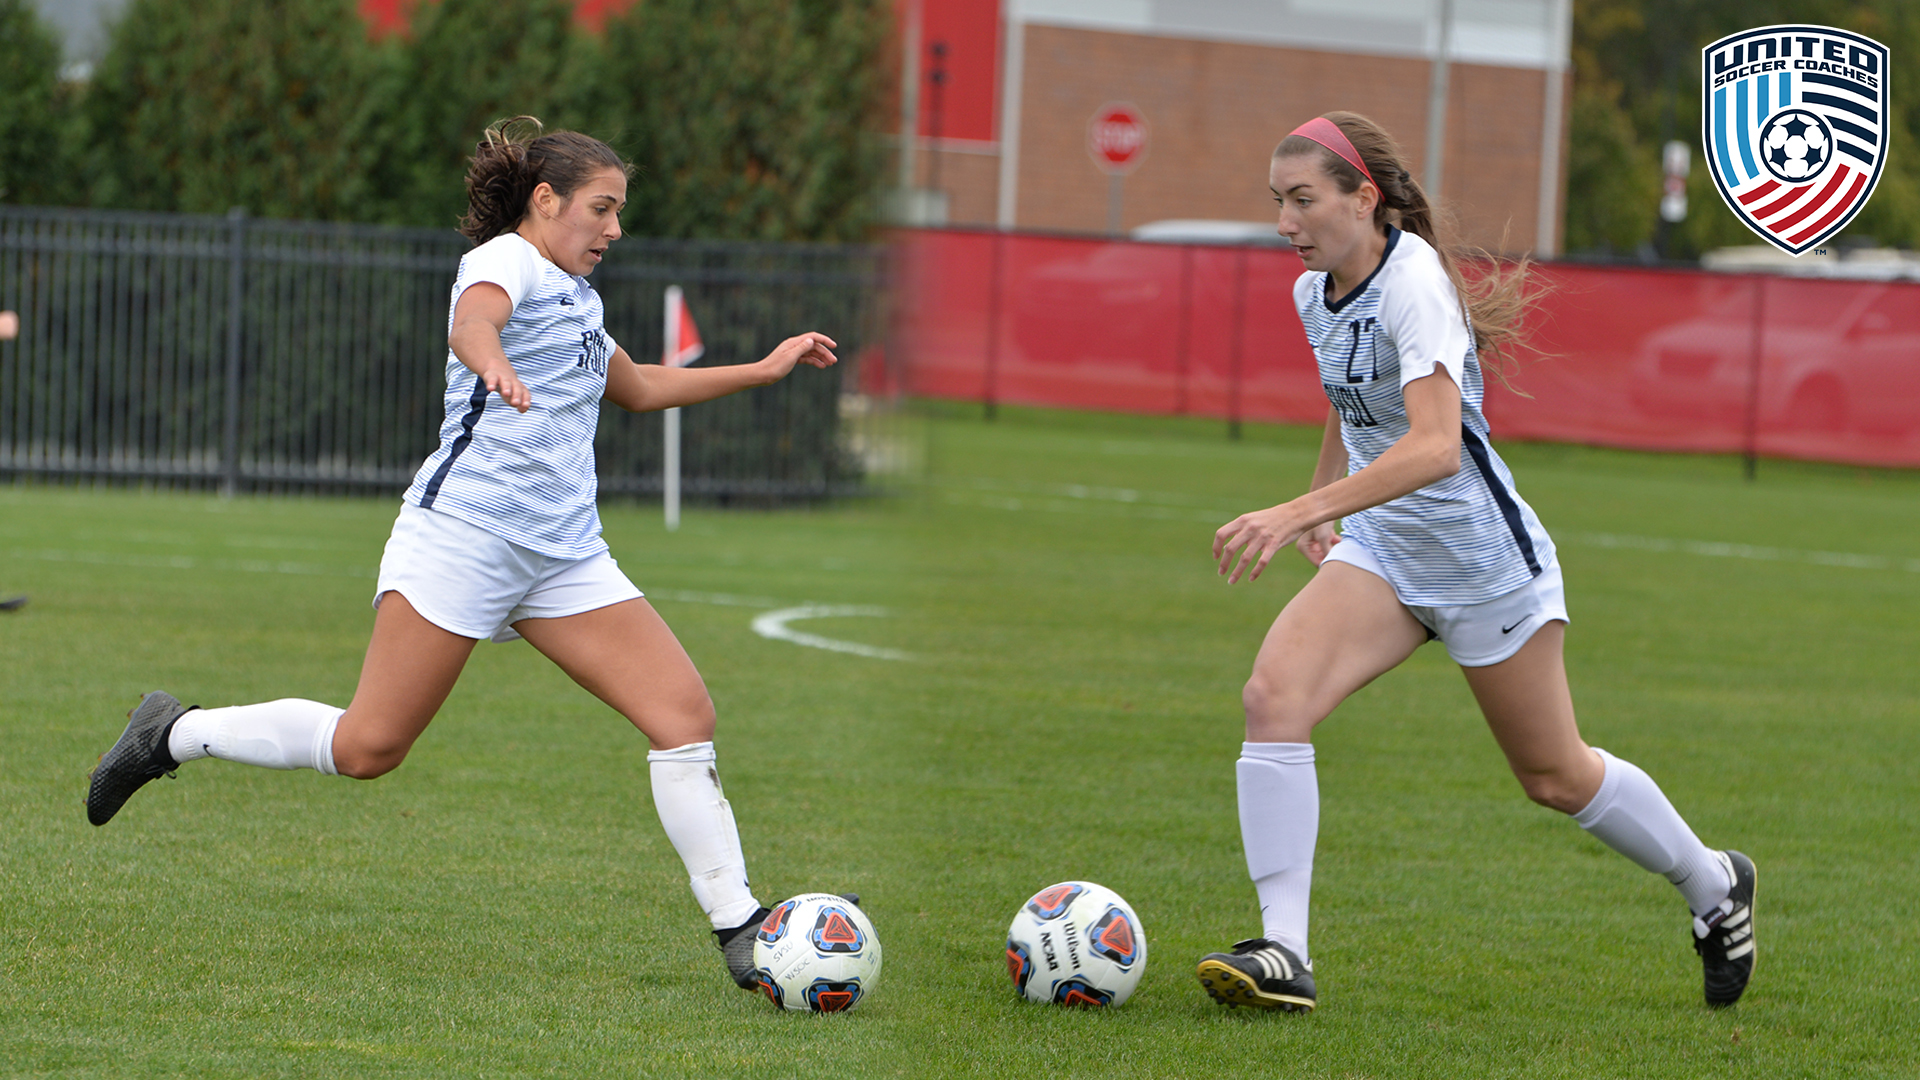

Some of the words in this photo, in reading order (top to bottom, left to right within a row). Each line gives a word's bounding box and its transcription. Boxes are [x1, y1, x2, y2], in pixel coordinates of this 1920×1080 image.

[1346, 317, 1379, 384] 27
[1041, 931, 1059, 972] NCAA
[1064, 922, 1082, 971] Wilson
